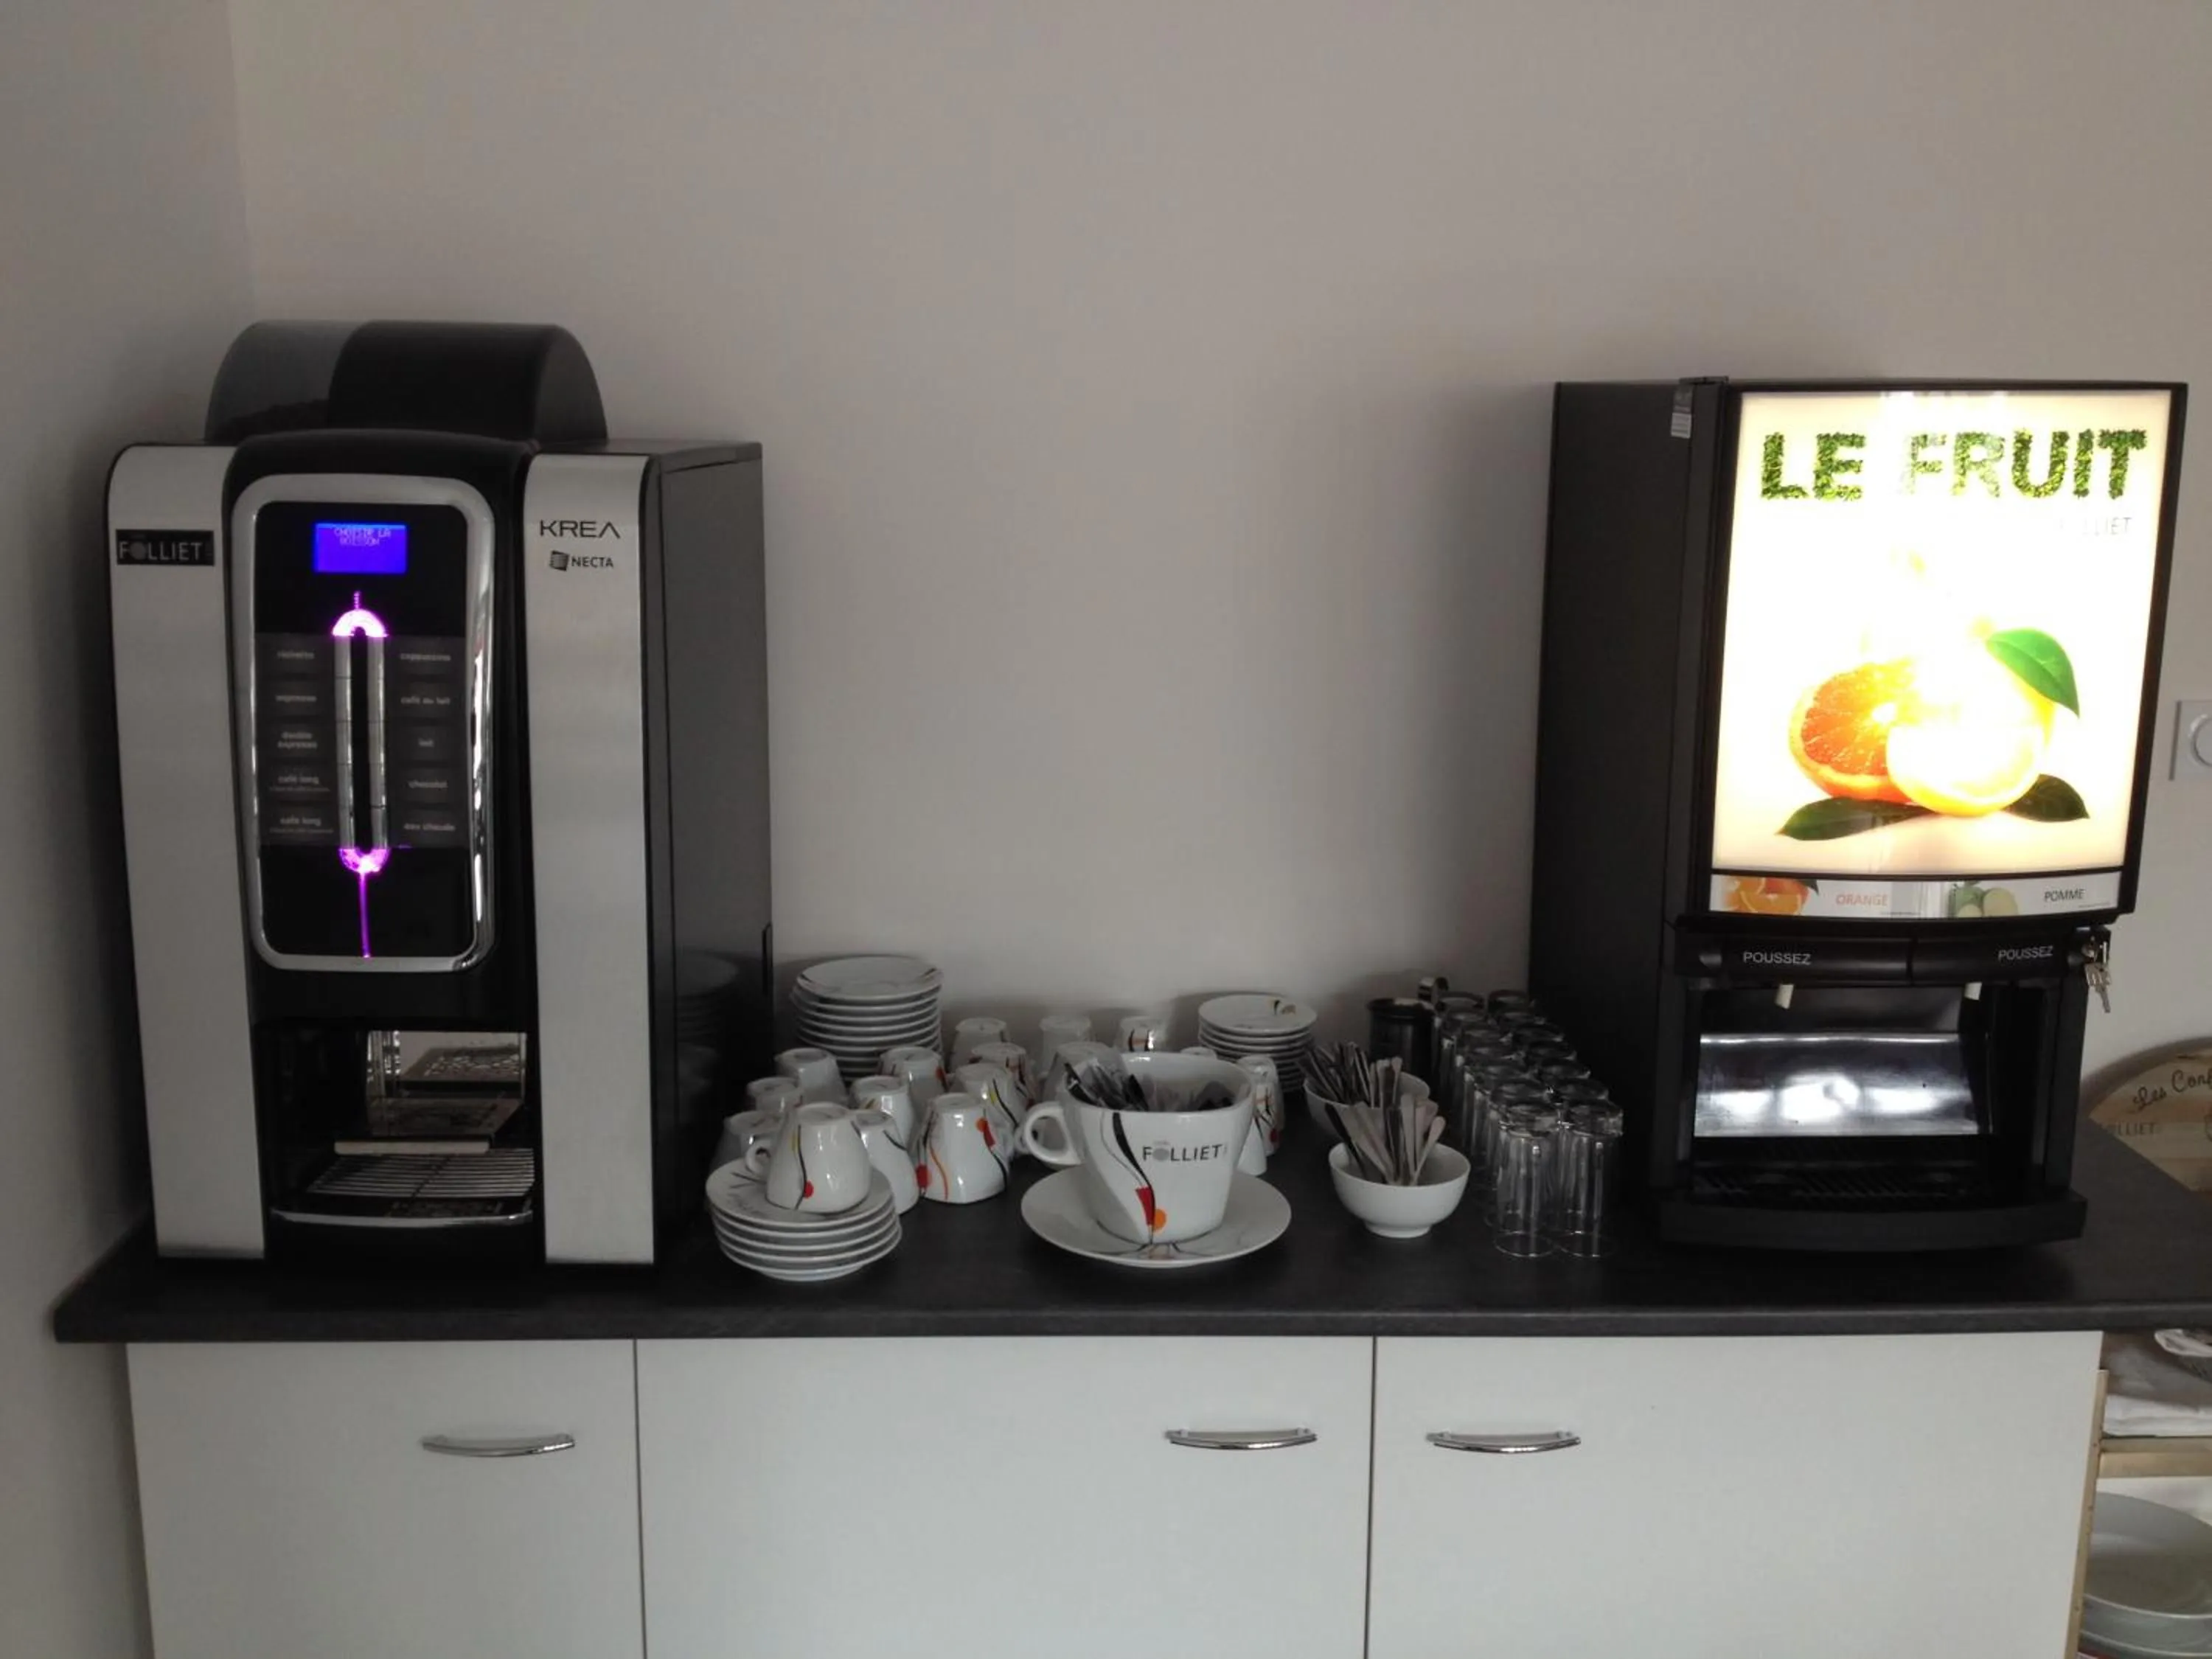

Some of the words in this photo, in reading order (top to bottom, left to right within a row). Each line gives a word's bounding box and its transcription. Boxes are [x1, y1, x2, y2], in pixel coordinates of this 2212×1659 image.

[1759, 431, 1865, 501] LE
[1897, 428, 2146, 499] FRUIT
[540, 519, 620, 539] KREA
[118, 540, 203, 560] FOLLIET
[571, 556, 613, 568] NECTA
[1836, 893, 1889, 906] ORANGE
[2044, 888, 2086, 902] POMME
[1742, 950, 1812, 965] POUSSEZ
[1997, 945, 2054, 961] POUSSEZ
[1143, 1144, 1223, 1162] FOLLIET
